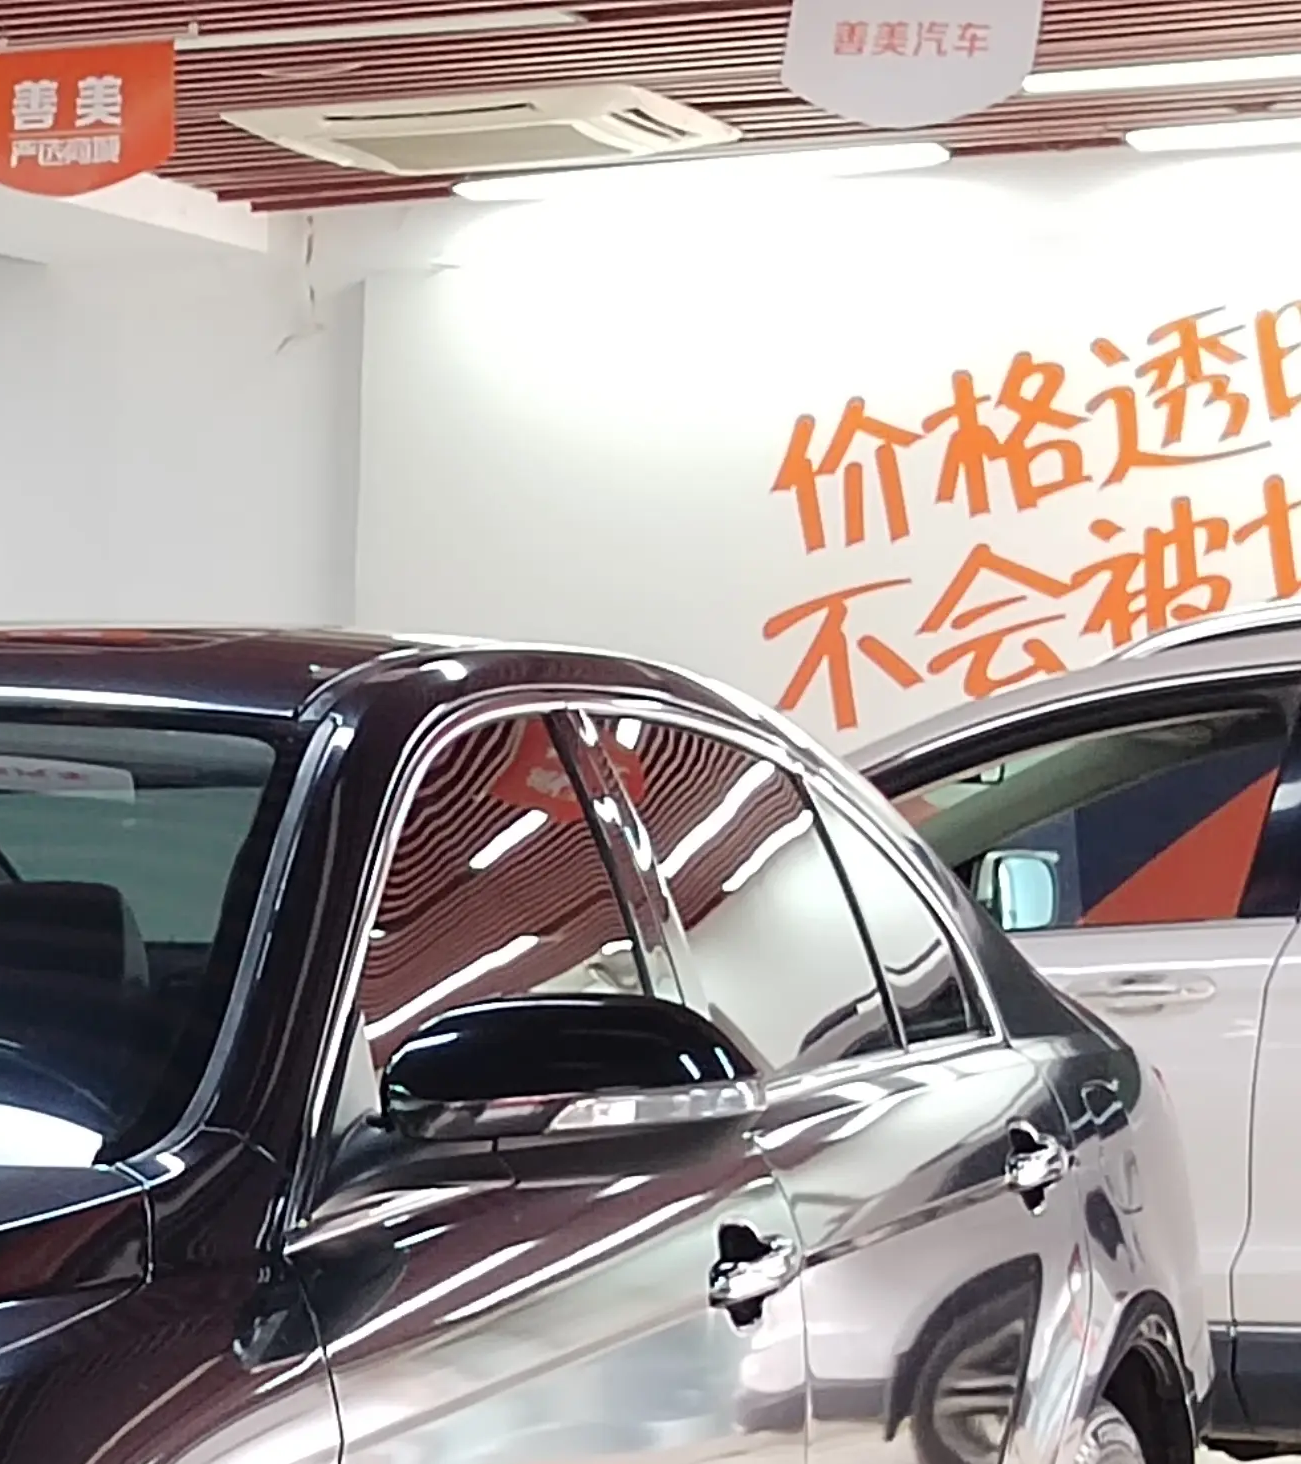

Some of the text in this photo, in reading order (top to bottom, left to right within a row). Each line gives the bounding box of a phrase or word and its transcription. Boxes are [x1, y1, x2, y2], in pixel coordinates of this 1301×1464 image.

[833, 20, 992, 58] 善美汽车
[11, 74, 123, 131] 善美
